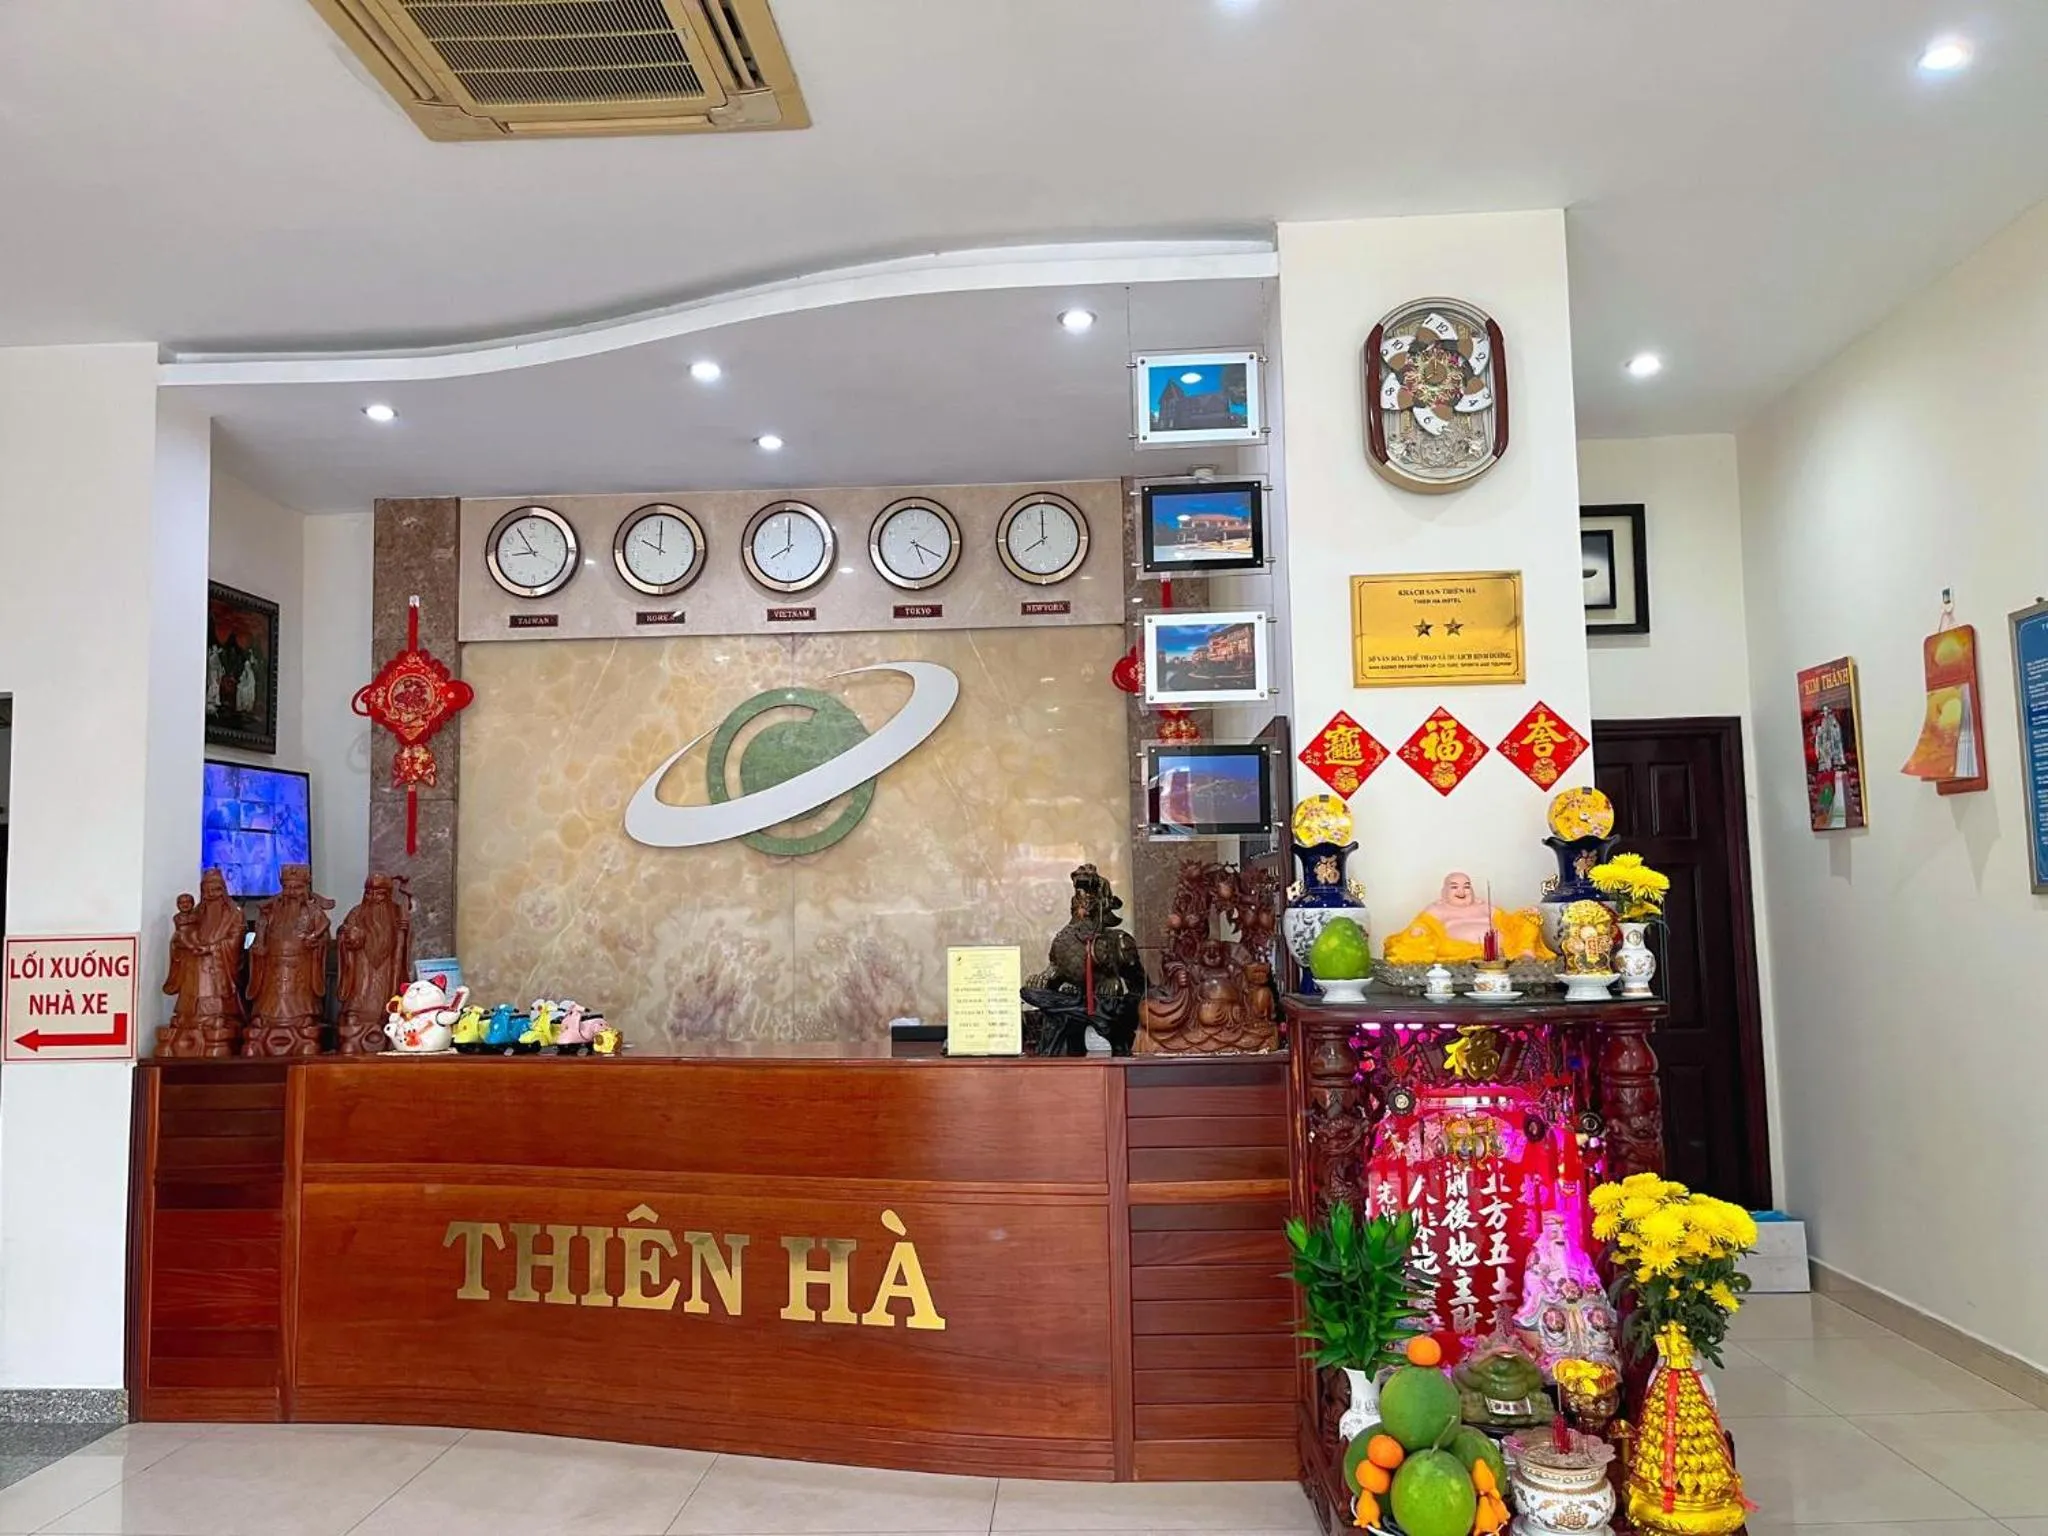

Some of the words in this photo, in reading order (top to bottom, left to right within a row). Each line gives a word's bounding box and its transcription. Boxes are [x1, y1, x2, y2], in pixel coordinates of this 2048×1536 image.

[517, 616, 550, 626] TAIWAN
[773, 609, 811, 619] VIETNAM
[905, 607, 931, 616] TOKYO
[1804, 676, 1820, 696] KIM
[1419, 719, 1463, 762] 福
[10, 950, 44, 979] LỐI
[50, 949, 130, 979] XUỐNG
[29, 989, 76, 1016] NHÀ
[81, 993, 108, 1015] XE
[442, 1203, 750, 1316] THIÊN
[780, 1209, 946, 1330] HÀ
